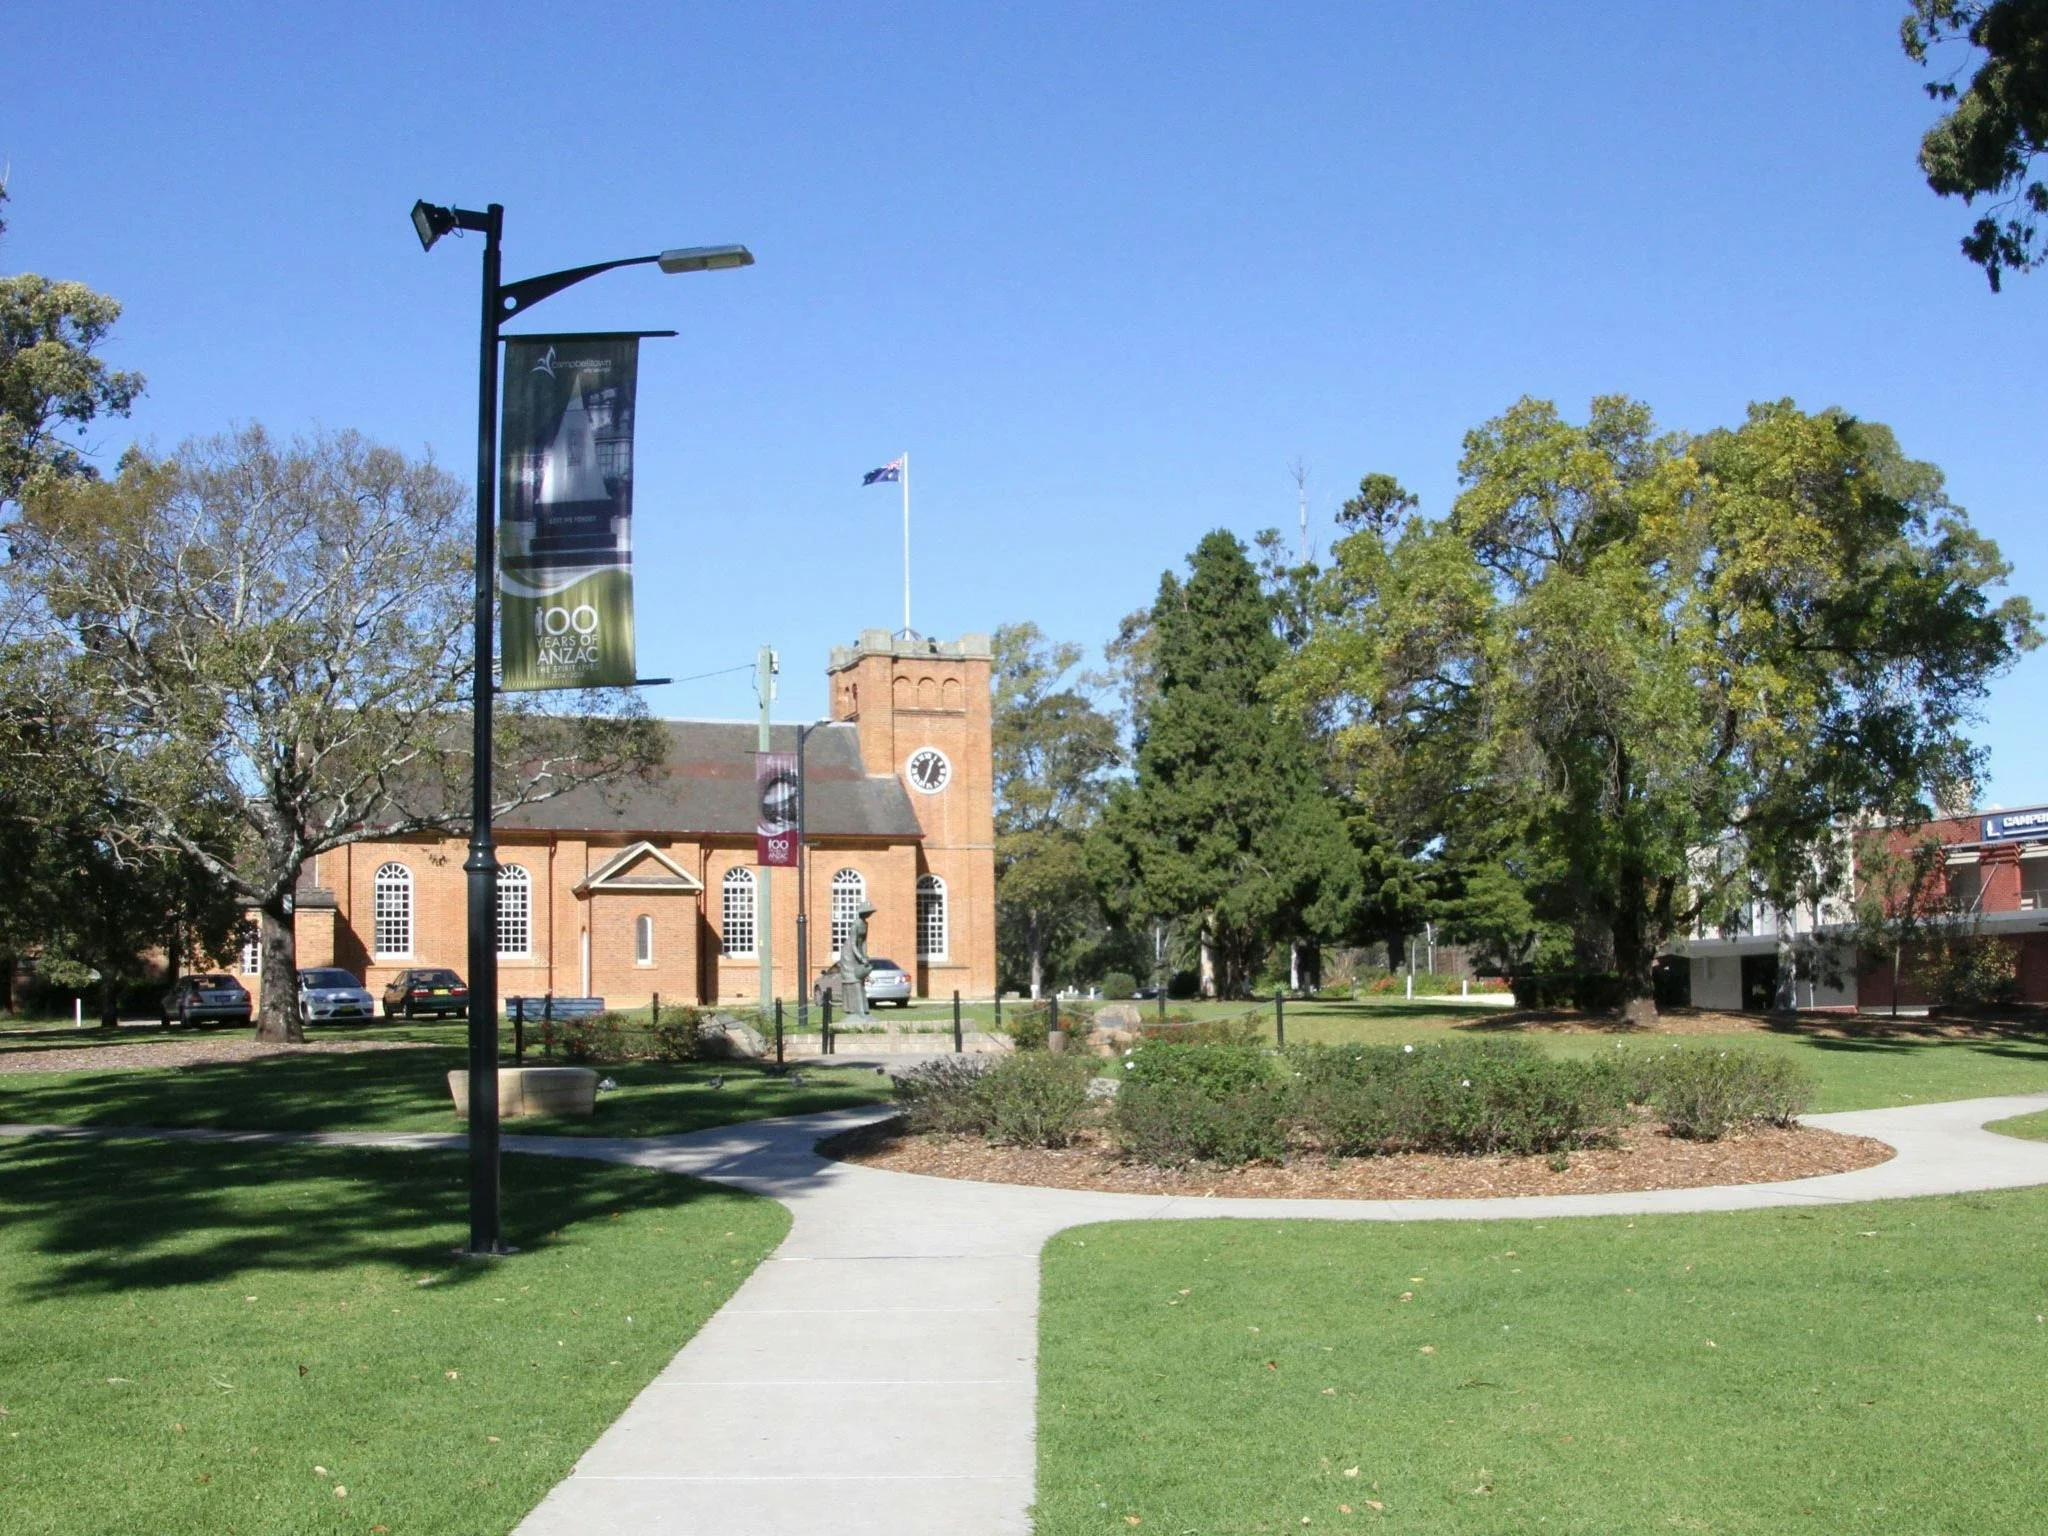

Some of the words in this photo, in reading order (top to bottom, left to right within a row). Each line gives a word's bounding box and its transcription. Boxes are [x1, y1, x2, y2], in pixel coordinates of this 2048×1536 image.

[535, 605, 598, 636] 100
[536, 635, 576, 648] YEARS
[580, 634, 599, 646] OF
[536, 646, 600, 665] ANZAC
[2003, 812, 2048, 827] CAMPB
[768, 839, 788, 849] 100
